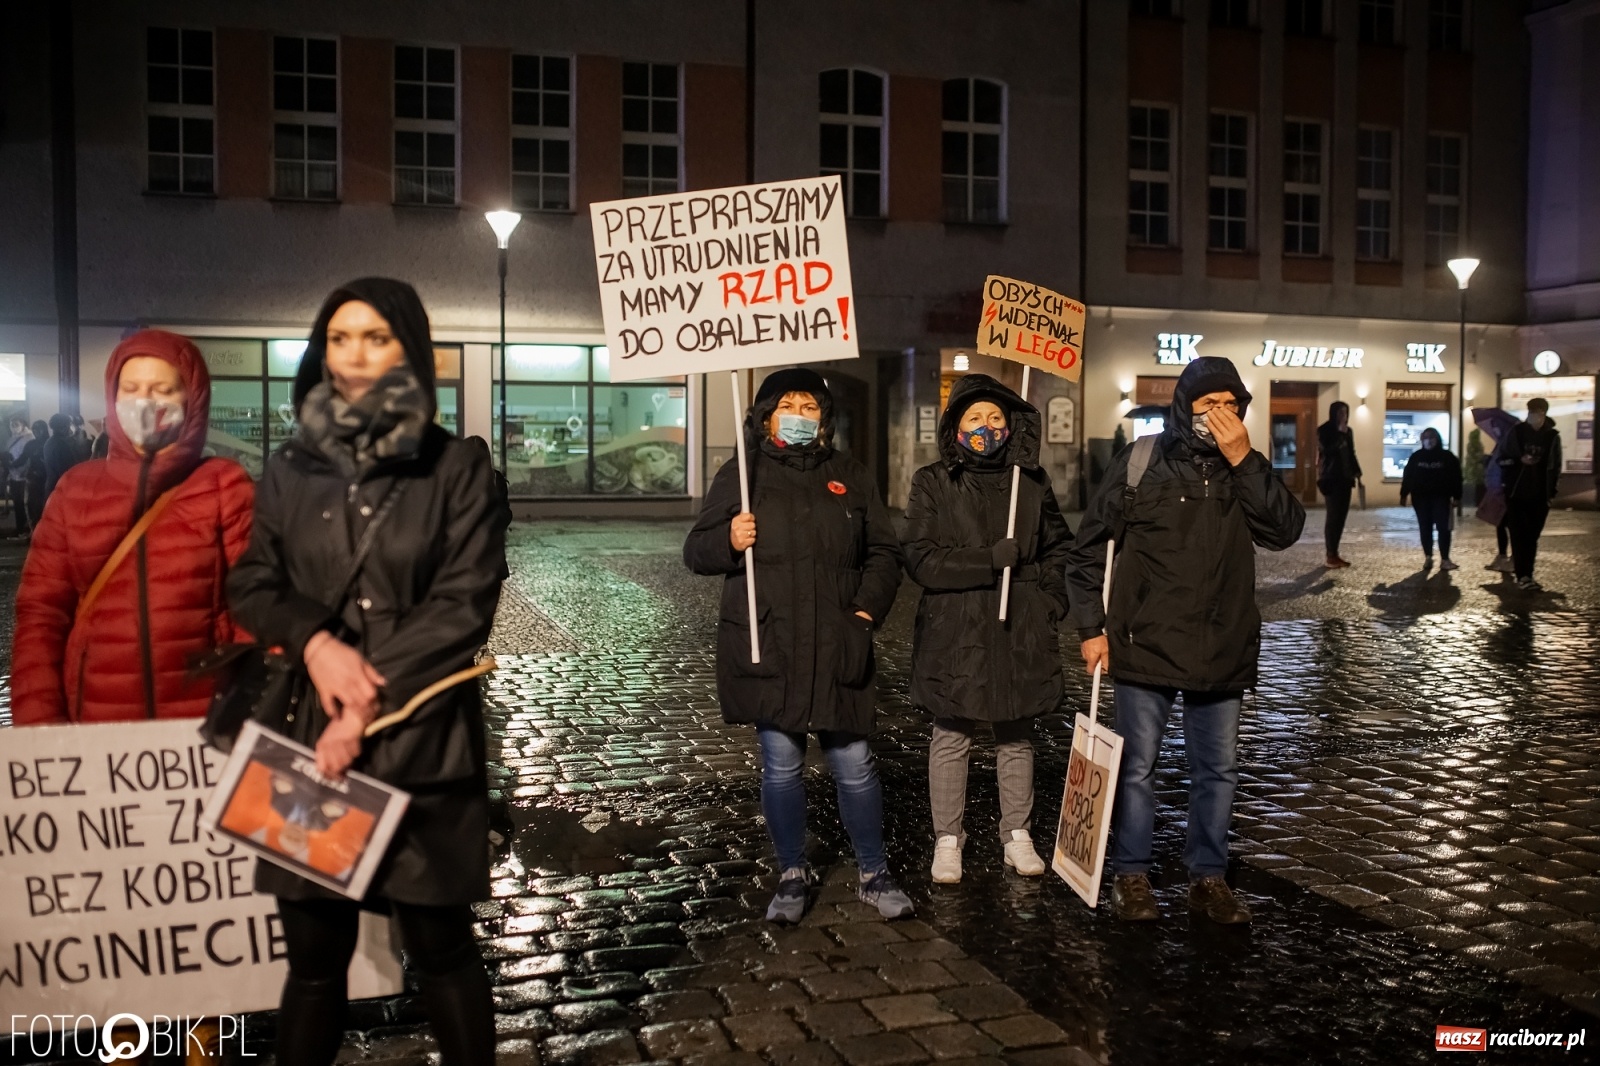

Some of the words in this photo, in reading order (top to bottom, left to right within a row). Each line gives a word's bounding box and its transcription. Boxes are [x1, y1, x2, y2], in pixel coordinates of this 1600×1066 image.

[600, 182, 838, 247] PRZEPRASZAMY
[599, 251, 634, 283] ZA
[641, 225, 820, 280] UTRUDNIENIA
[620, 281, 703, 321] MAMY
[718, 261, 833, 309] RZĄD
[618, 327, 663, 359] DO
[988, 324, 1008, 348] W
[1015, 331, 1076, 370] LEGO
[1253, 340, 1364, 369] JUBILER
[8, 757, 86, 799] BEZ
[0, 811, 58, 856] KO
[78, 804, 145, 851] NIE
[26, 871, 106, 917] BEZ
[123, 856, 252, 909] KOBIE
